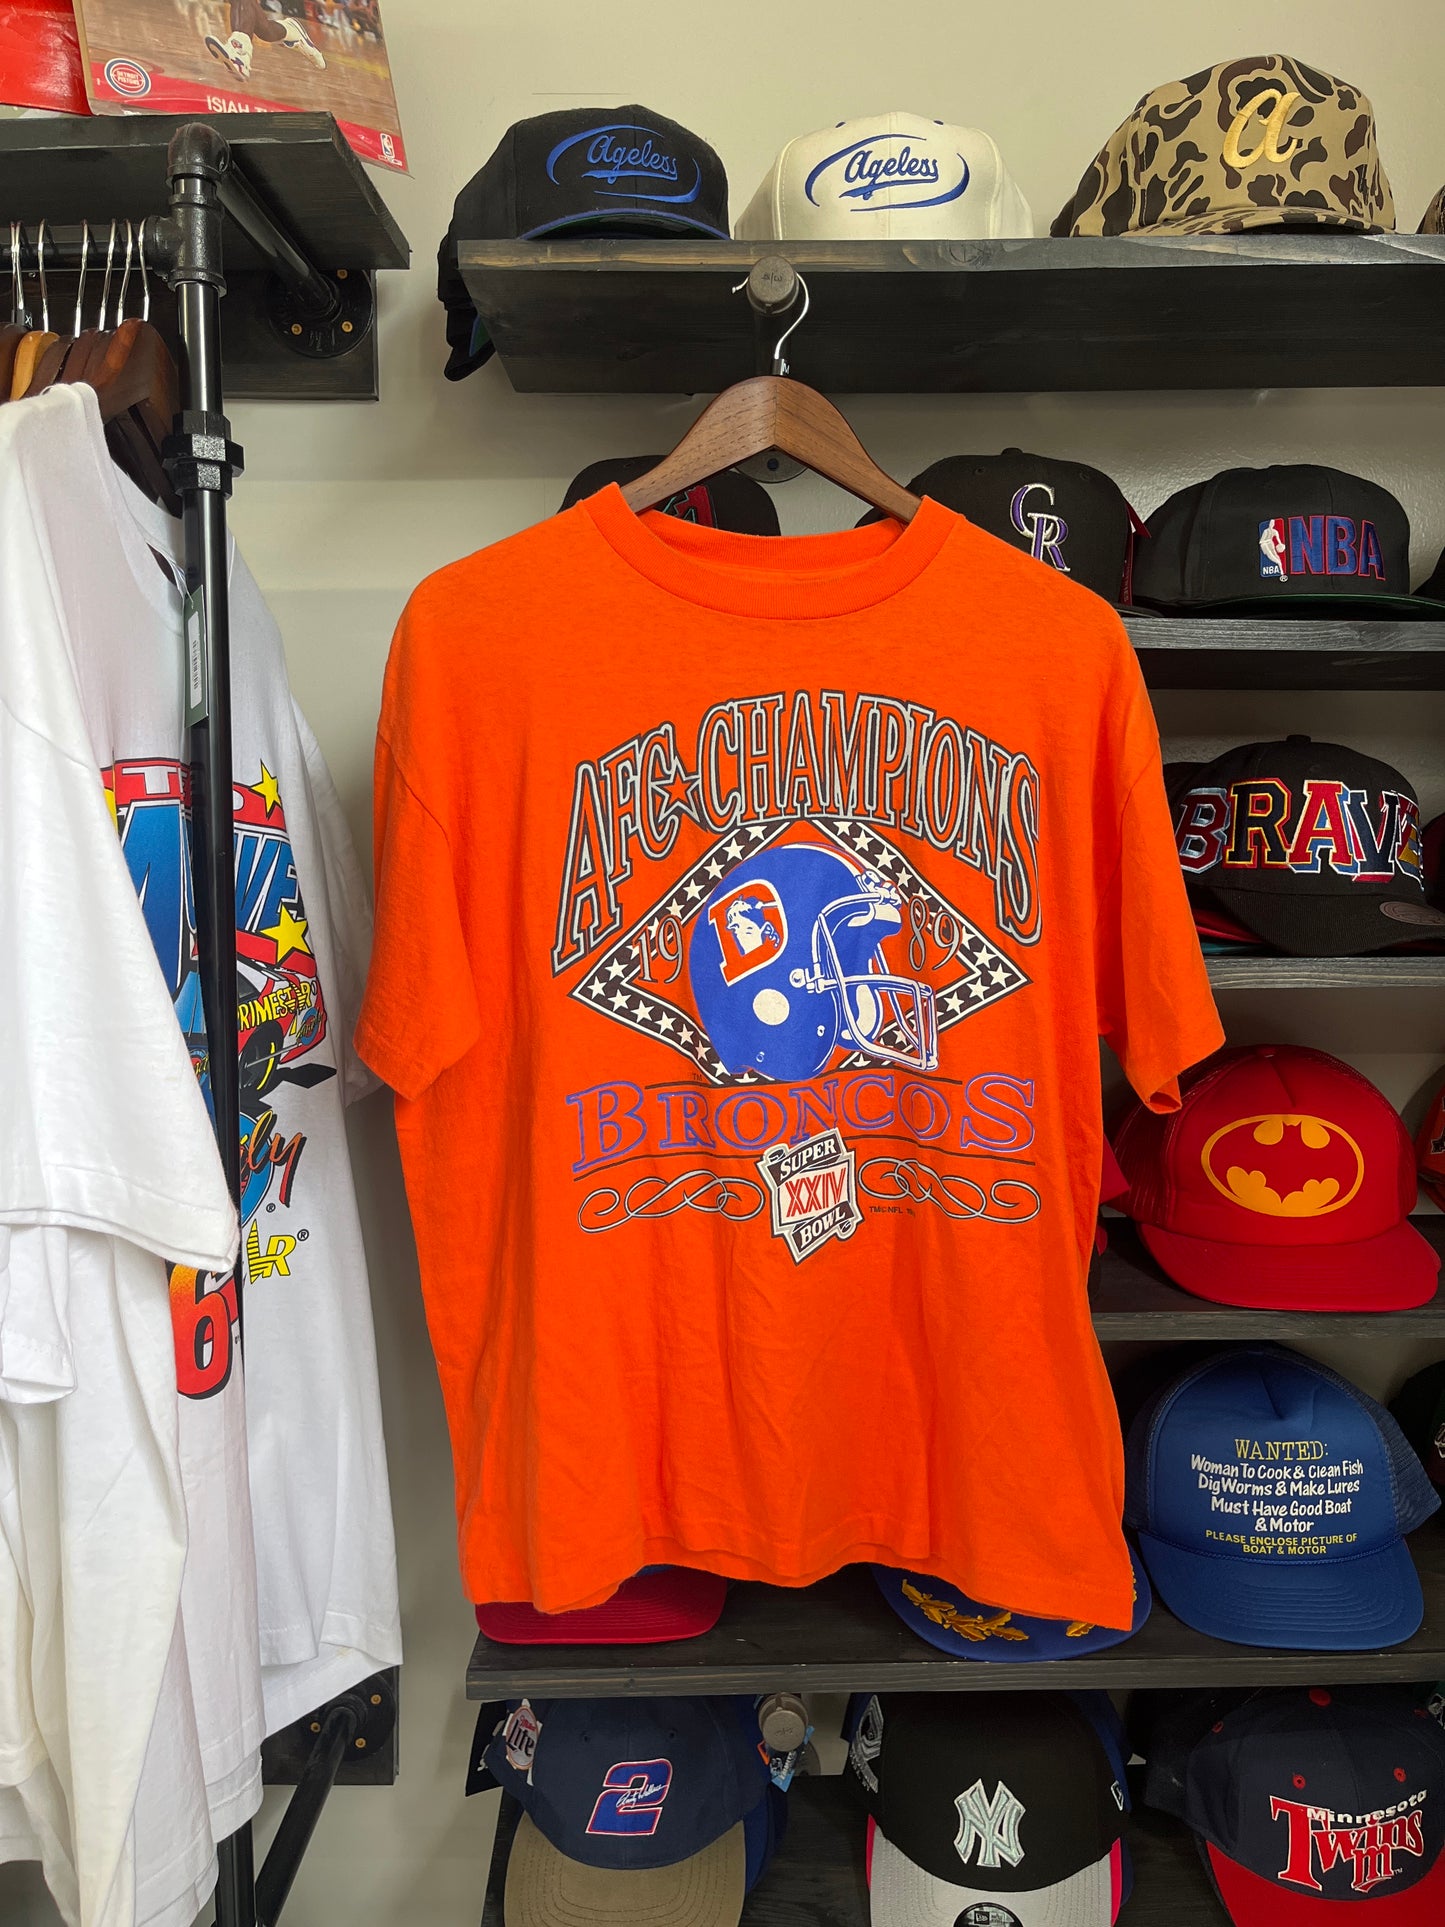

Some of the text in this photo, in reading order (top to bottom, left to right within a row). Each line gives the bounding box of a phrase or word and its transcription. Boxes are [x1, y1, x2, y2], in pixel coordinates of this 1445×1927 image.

[206, 95, 250, 113] ISIAH
[581, 134, 678, 185] Ageless
[839, 146, 939, 200] Ageless
[1287, 514, 1386, 581] NBA
[1262, 565, 1280, 575] NBA
[550, 688, 1040, 978] AFC CHAMPIONS
[566, 1072, 1036, 1174] BRONCOS
[780, 1138, 837, 1181] SUPER
[784, 1167, 847, 1218] XXIV
[800, 1206, 845, 1249] BOWL
[1191, 1453, 1363, 1480] Woman To Cook & Clean Fish
[1234, 1438, 1328, 1461] WANTED:
[1198, 1472, 1360, 1497] Dig Worms & Make Lures
[1211, 1495, 1352, 1517] Must Have Good Boat
[1254, 1517, 1315, 1533] & Motor
[1205, 1529, 1358, 1546] PLEASE ENCLOSE PICTURE OF
[1243, 1544, 1327, 1555] BOAT & MOTOR
[506, 1718, 535, 1757] Lite
[585, 1758, 673, 1836] 2
[1306, 1789, 1427, 1825] Minnesota
[953, 1778, 1026, 1867] NY
[1269, 1795, 1424, 1892] Twins
